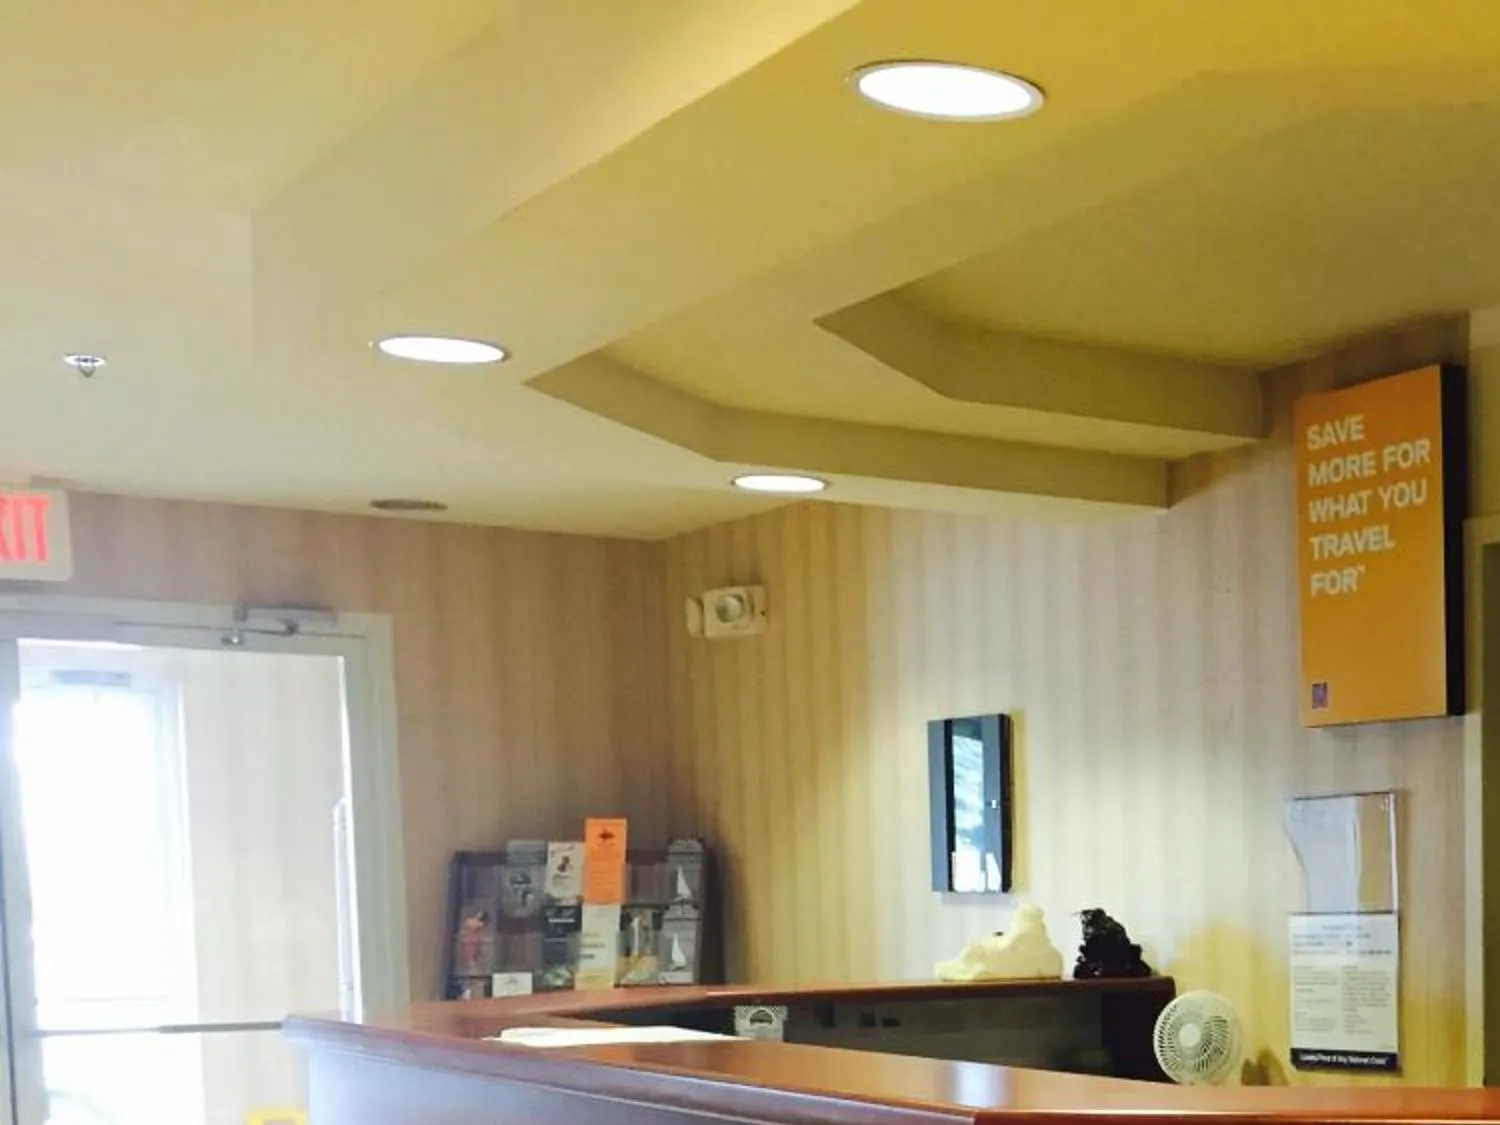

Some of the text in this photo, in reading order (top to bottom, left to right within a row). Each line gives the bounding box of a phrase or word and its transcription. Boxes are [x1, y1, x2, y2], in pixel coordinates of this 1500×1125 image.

[1306, 414, 1365, 451] SAVE
[1308, 438, 1431, 487] MORE FOR
[1309, 479, 1428, 524] WHAT YOU
[1310, 525, 1396, 560] TRAVEL
